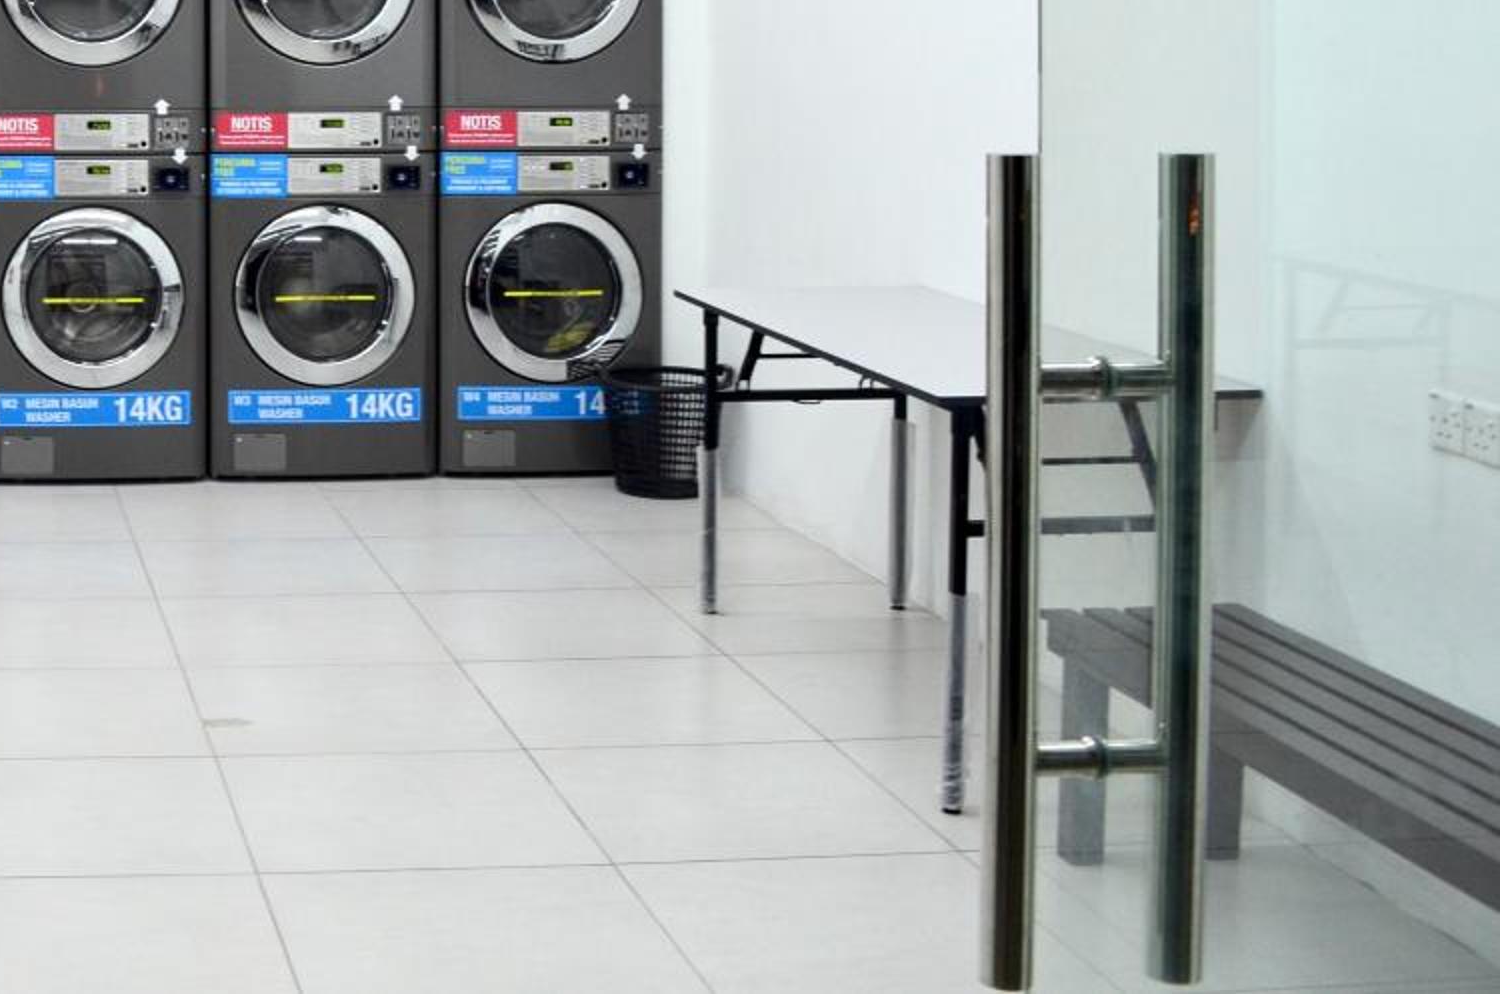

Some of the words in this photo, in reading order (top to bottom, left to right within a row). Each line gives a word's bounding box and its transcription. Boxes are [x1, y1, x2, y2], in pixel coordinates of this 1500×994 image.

[230, 116, 273, 131] NOTIS
[460, 115, 502, 130] NOTIS
[258, 395, 292, 406] MESIN
[487, 391, 522, 402] MESIN
[25, 398, 60, 409] MESIN
[113, 395, 182, 422] 14KG
[345, 392, 414, 419] 14KG
[258, 408, 304, 419] WASHER
[487, 405, 534, 416] WASHER
[25, 411, 72, 422] WASHER
